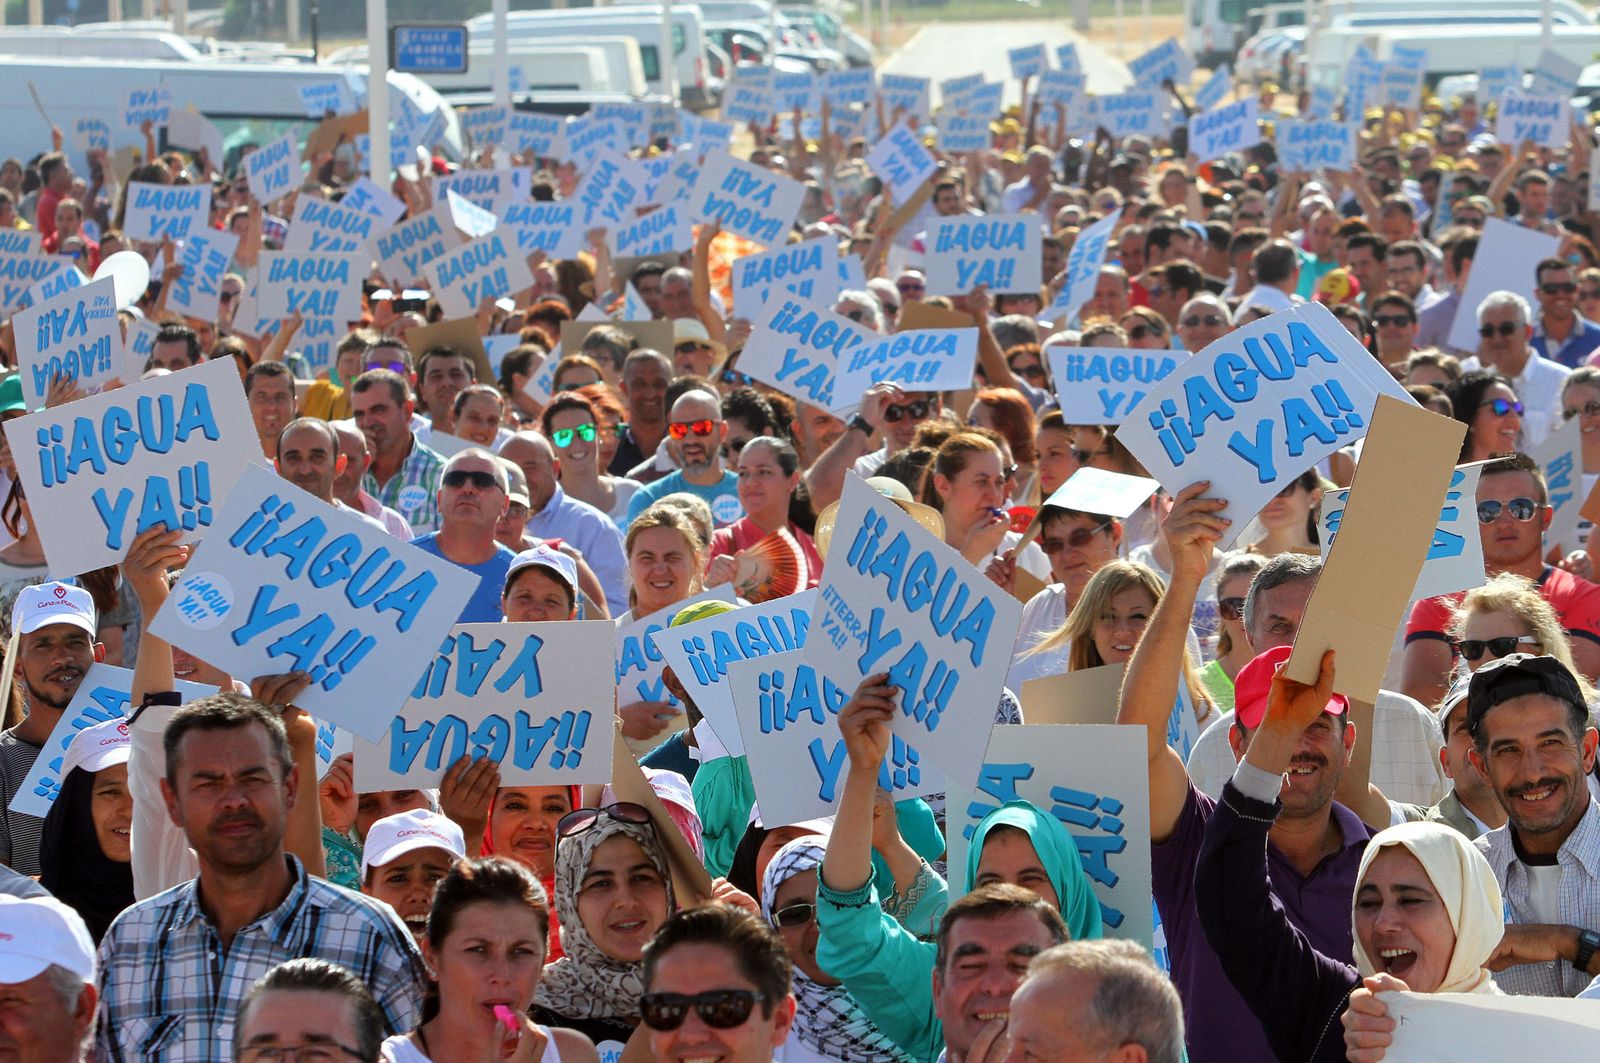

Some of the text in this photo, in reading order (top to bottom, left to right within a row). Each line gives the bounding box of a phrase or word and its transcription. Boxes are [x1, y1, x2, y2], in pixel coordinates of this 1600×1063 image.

[135, 188, 200, 210] ¡¡AGUA
[436, 236, 507, 289] ¡¡AGUA
[936, 222, 1026, 252] ¡¡AGUA
[42, 267, 81, 301] ¡¡AG
[268, 258, 349, 284] ¡¡AGUA
[741, 245, 822, 288] ¡¡AGUA
[956, 257, 1015, 289] YA!!
[286, 287, 339, 316] YA!!
[848, 333, 957, 372] ¡¡AGUA
[1149, 321, 1339, 467] ¡¡AGUA
[36, 382, 221, 488] ¡¡AGUA
[1228, 379, 1364, 484] YA!!
[92, 461, 213, 550] YA!!
[228, 494, 438, 633] ¡¡AGUA
[846, 507, 996, 668] ¡¡AGUA
[231, 584, 377, 692] YA!!
[858, 607, 960, 732] YA!!
